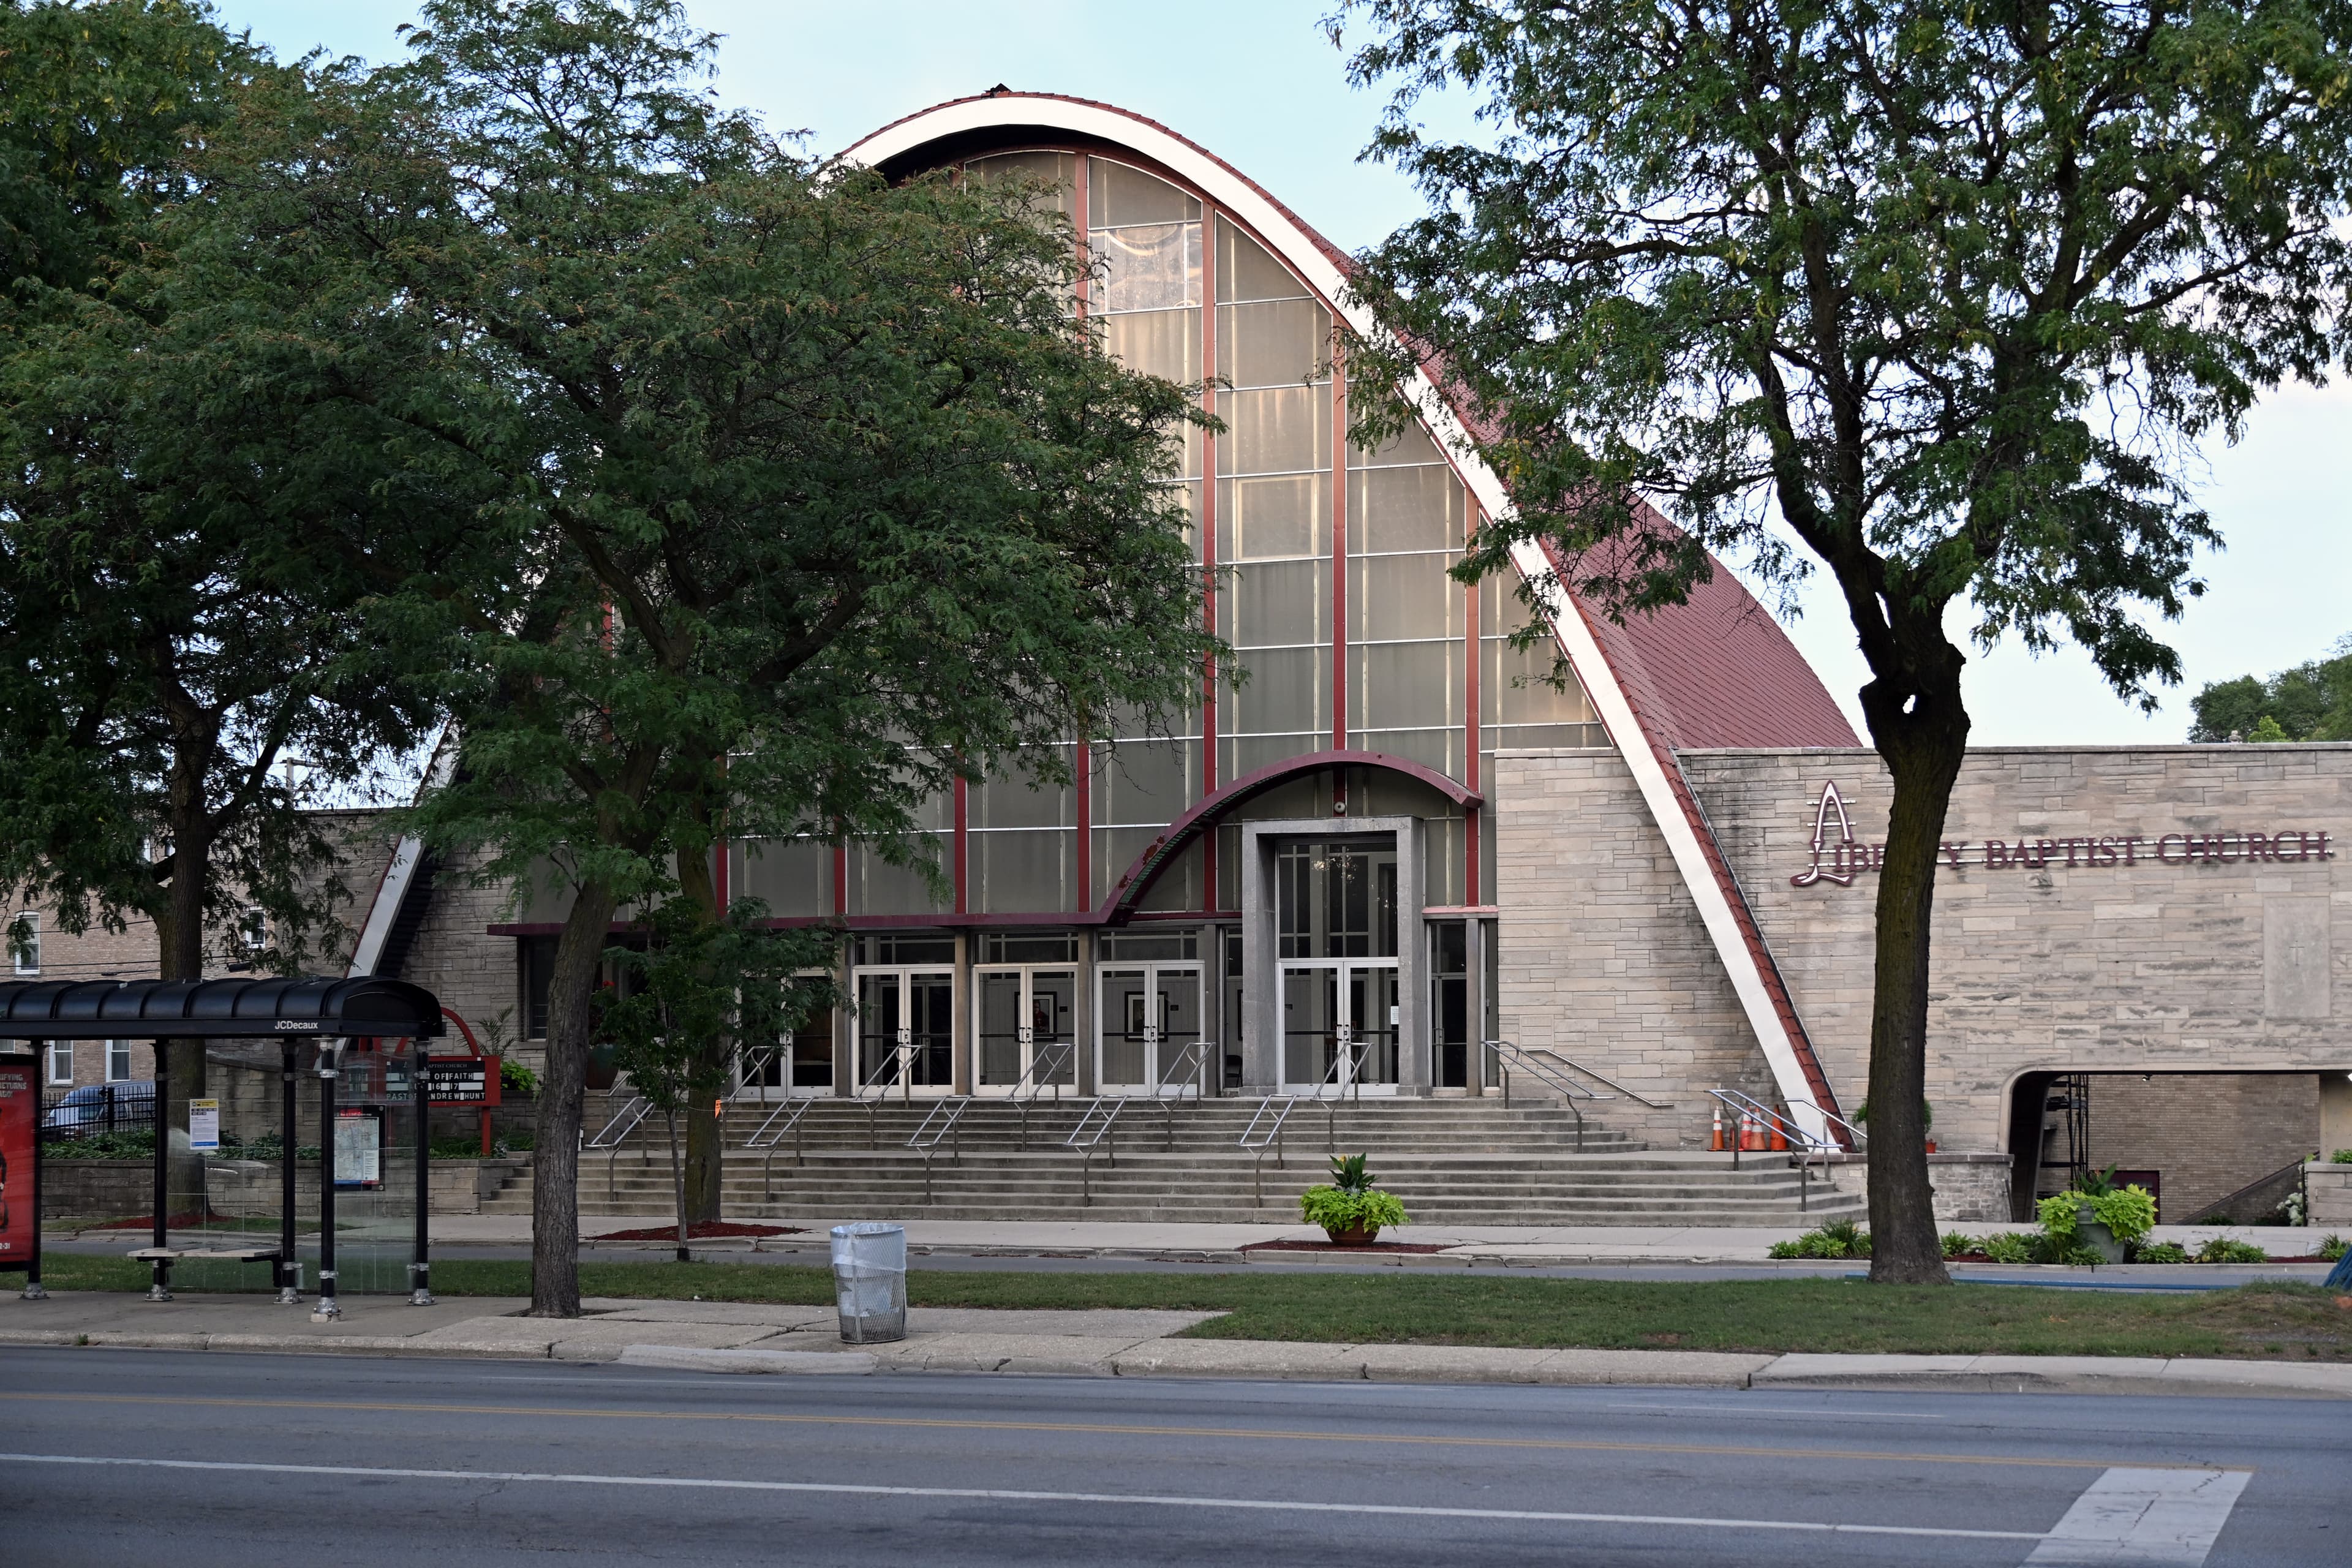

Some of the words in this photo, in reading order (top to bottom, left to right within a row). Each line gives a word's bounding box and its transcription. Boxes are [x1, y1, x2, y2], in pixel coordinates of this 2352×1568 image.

[1790, 779, 1968, 887] LIBEY
[1984, 836, 2143, 869] BAPTIST
[2157, 831, 2328, 865] CHURCH
[274, 1020, 318, 1030] JCDecaux
